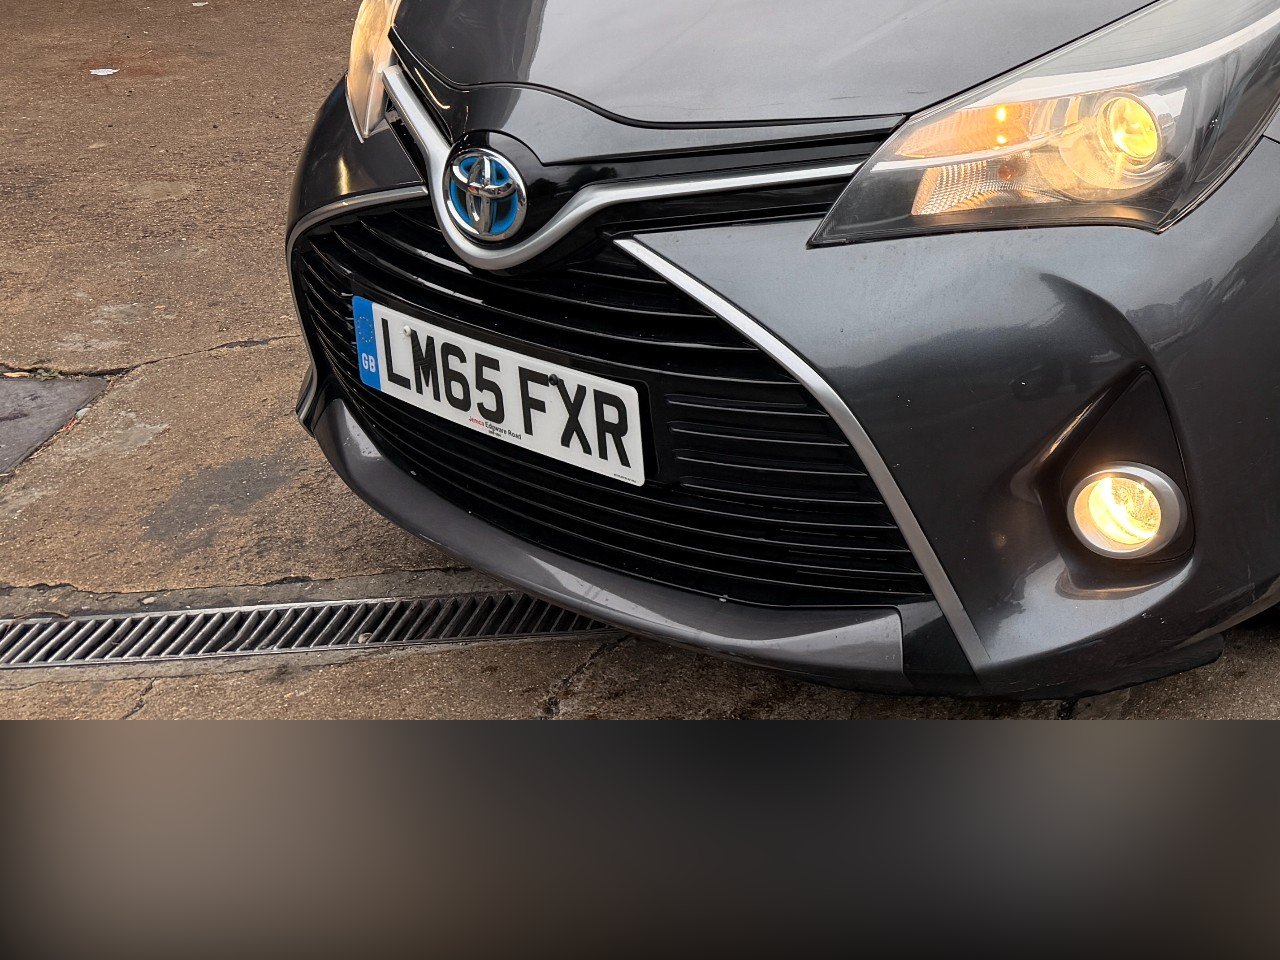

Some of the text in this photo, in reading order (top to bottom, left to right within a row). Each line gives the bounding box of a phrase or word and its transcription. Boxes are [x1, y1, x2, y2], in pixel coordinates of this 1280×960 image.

[361, 352, 376, 371] GB
[381, 318, 631, 468] LM65 FXR
